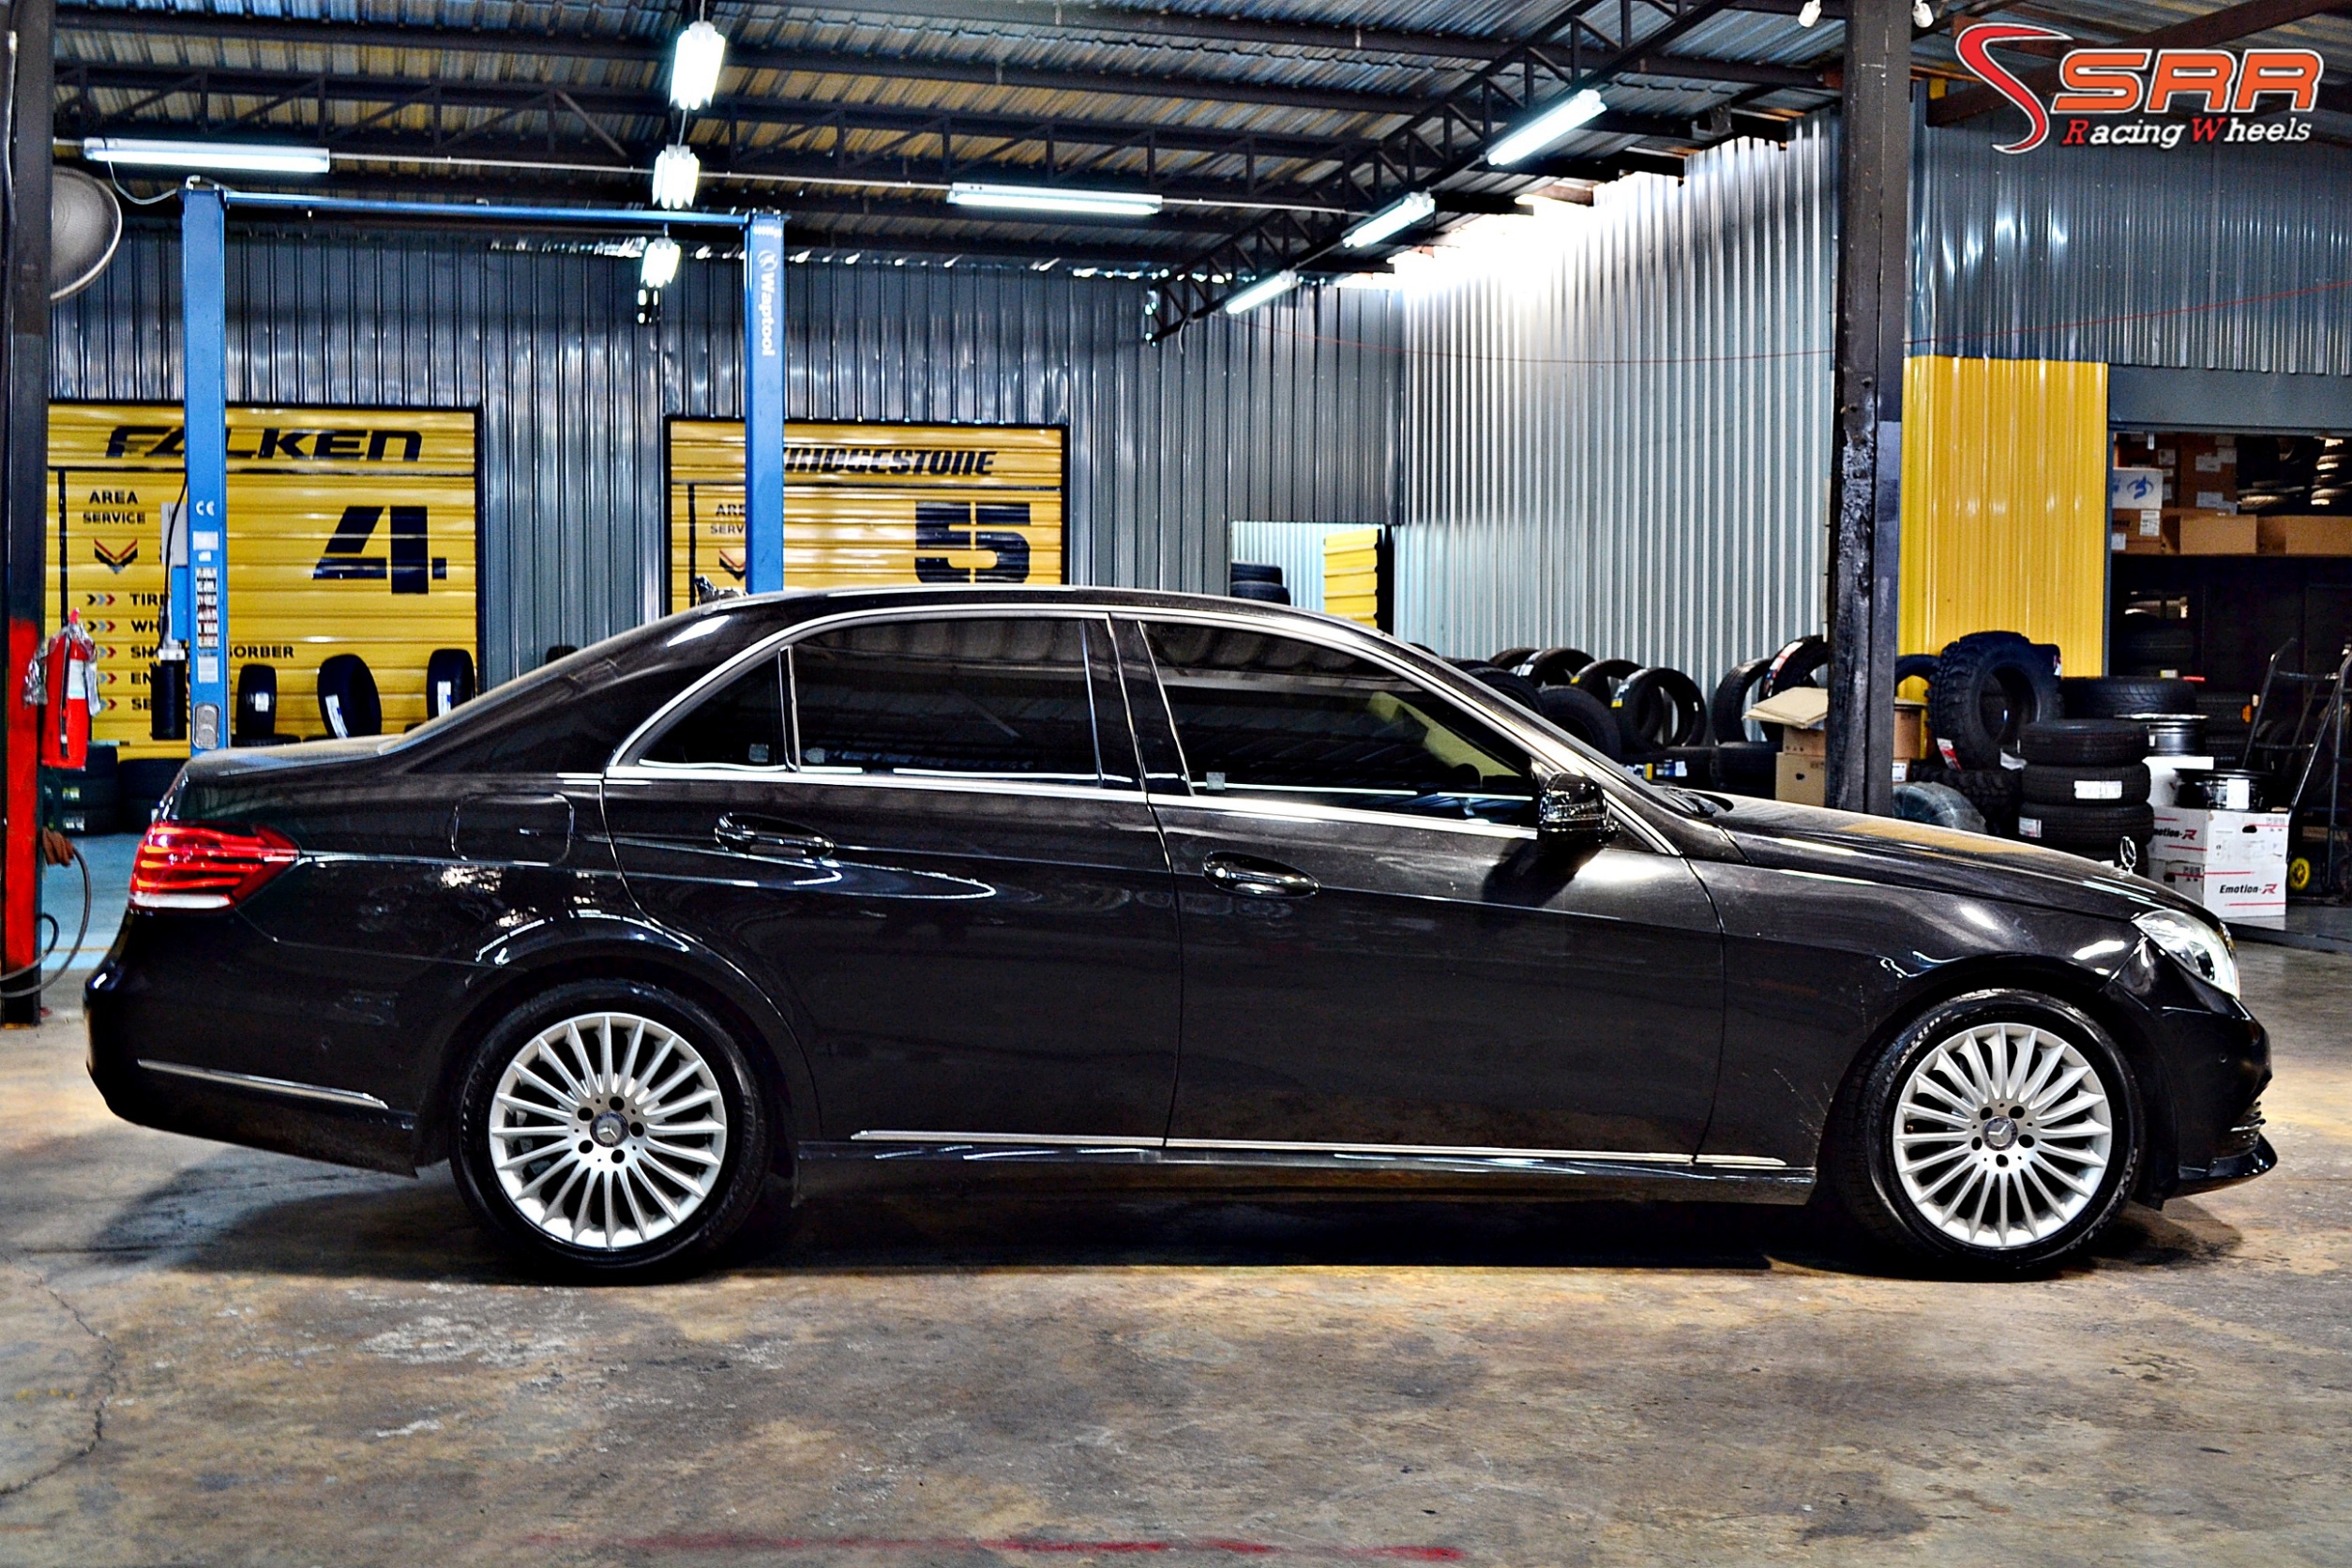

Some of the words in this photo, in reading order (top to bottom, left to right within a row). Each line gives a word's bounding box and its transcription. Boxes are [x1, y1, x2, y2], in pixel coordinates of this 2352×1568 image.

[758, 271, 776, 356] Waptool
[783, 446, 998, 475] RIDGESTONE
[83, 512, 146, 524] SERVICE
[89, 490, 138, 505] AREA
[312, 506, 447, 595] 4
[914, 501, 1031, 583] 5
